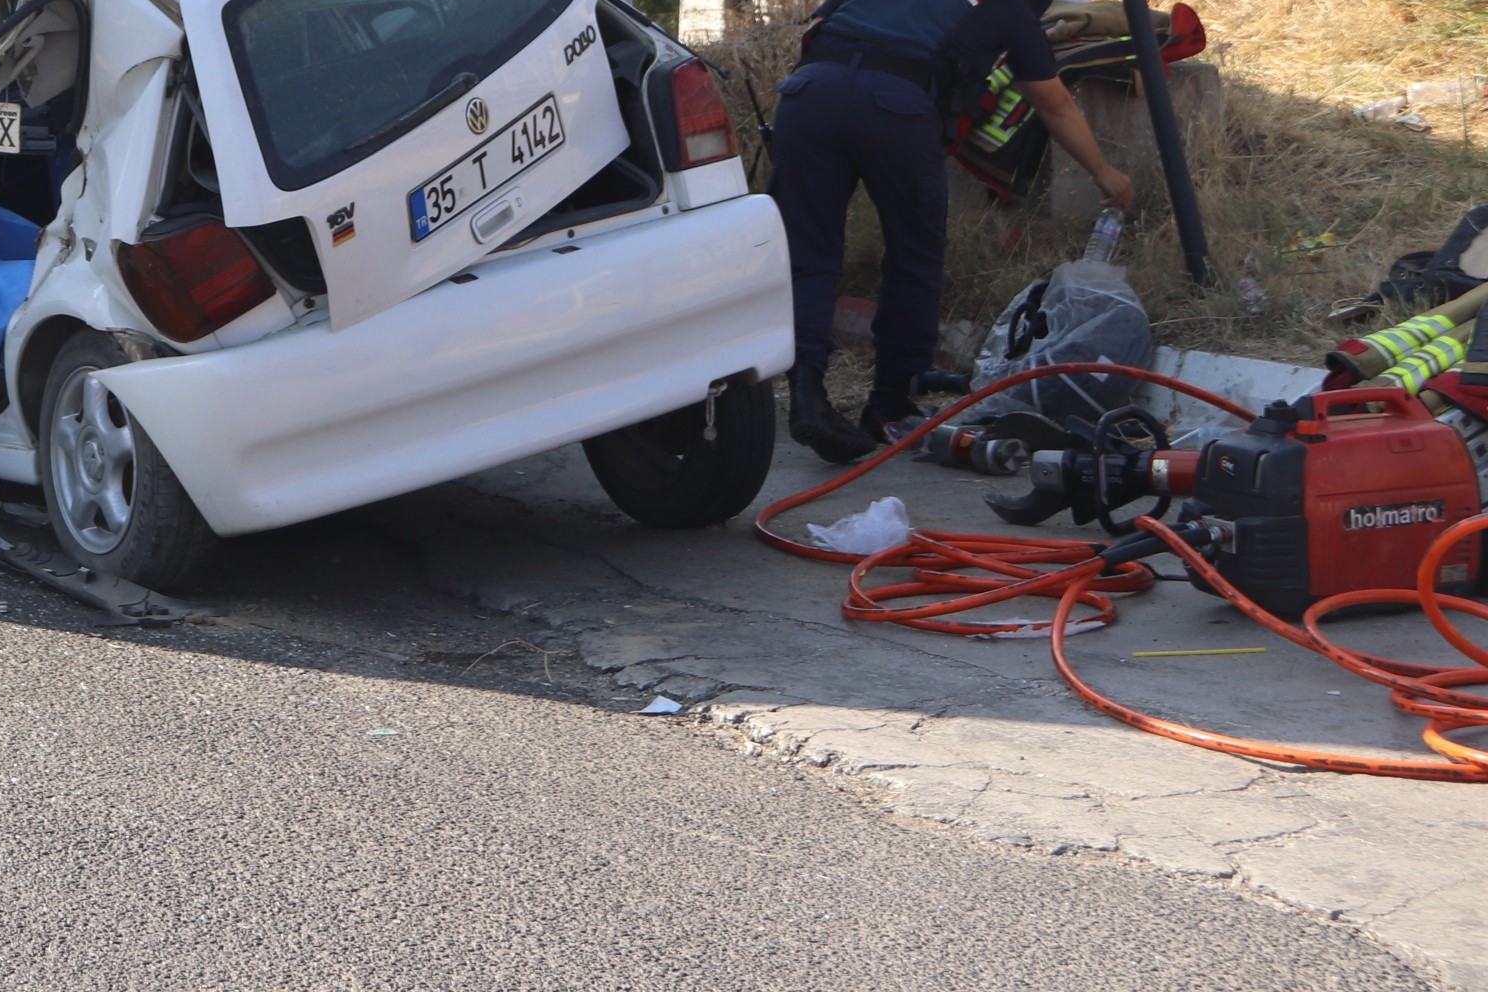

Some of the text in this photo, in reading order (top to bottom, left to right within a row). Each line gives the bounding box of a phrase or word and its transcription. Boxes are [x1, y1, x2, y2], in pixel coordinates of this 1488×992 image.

[416, 105, 561, 230] TR 35 T 4142
[1349, 504, 1438, 529] holmatro
